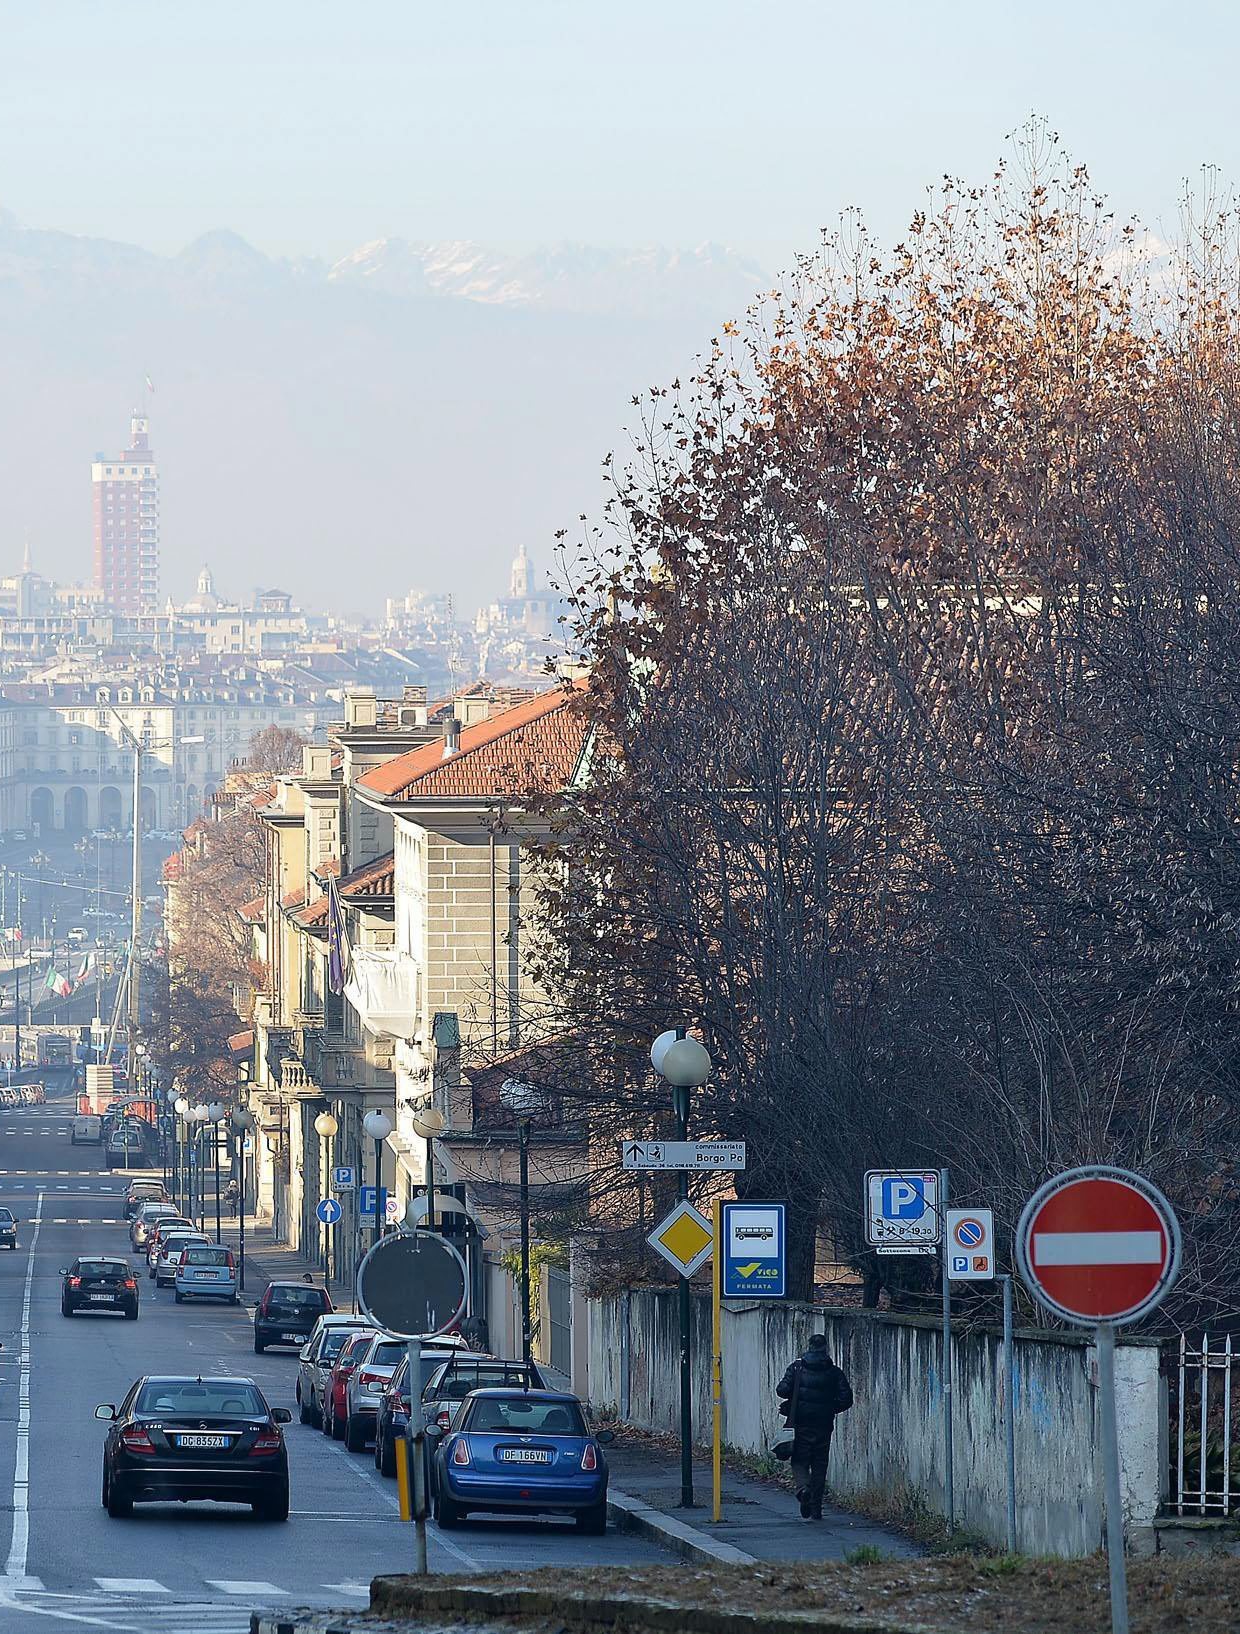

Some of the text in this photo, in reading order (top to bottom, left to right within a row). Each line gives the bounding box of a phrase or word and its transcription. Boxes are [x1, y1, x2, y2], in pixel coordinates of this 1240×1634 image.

[696, 1153, 743, 1164] Borgo Po
[891, 1182, 917, 1216] P
[955, 1259, 965, 1271] P
